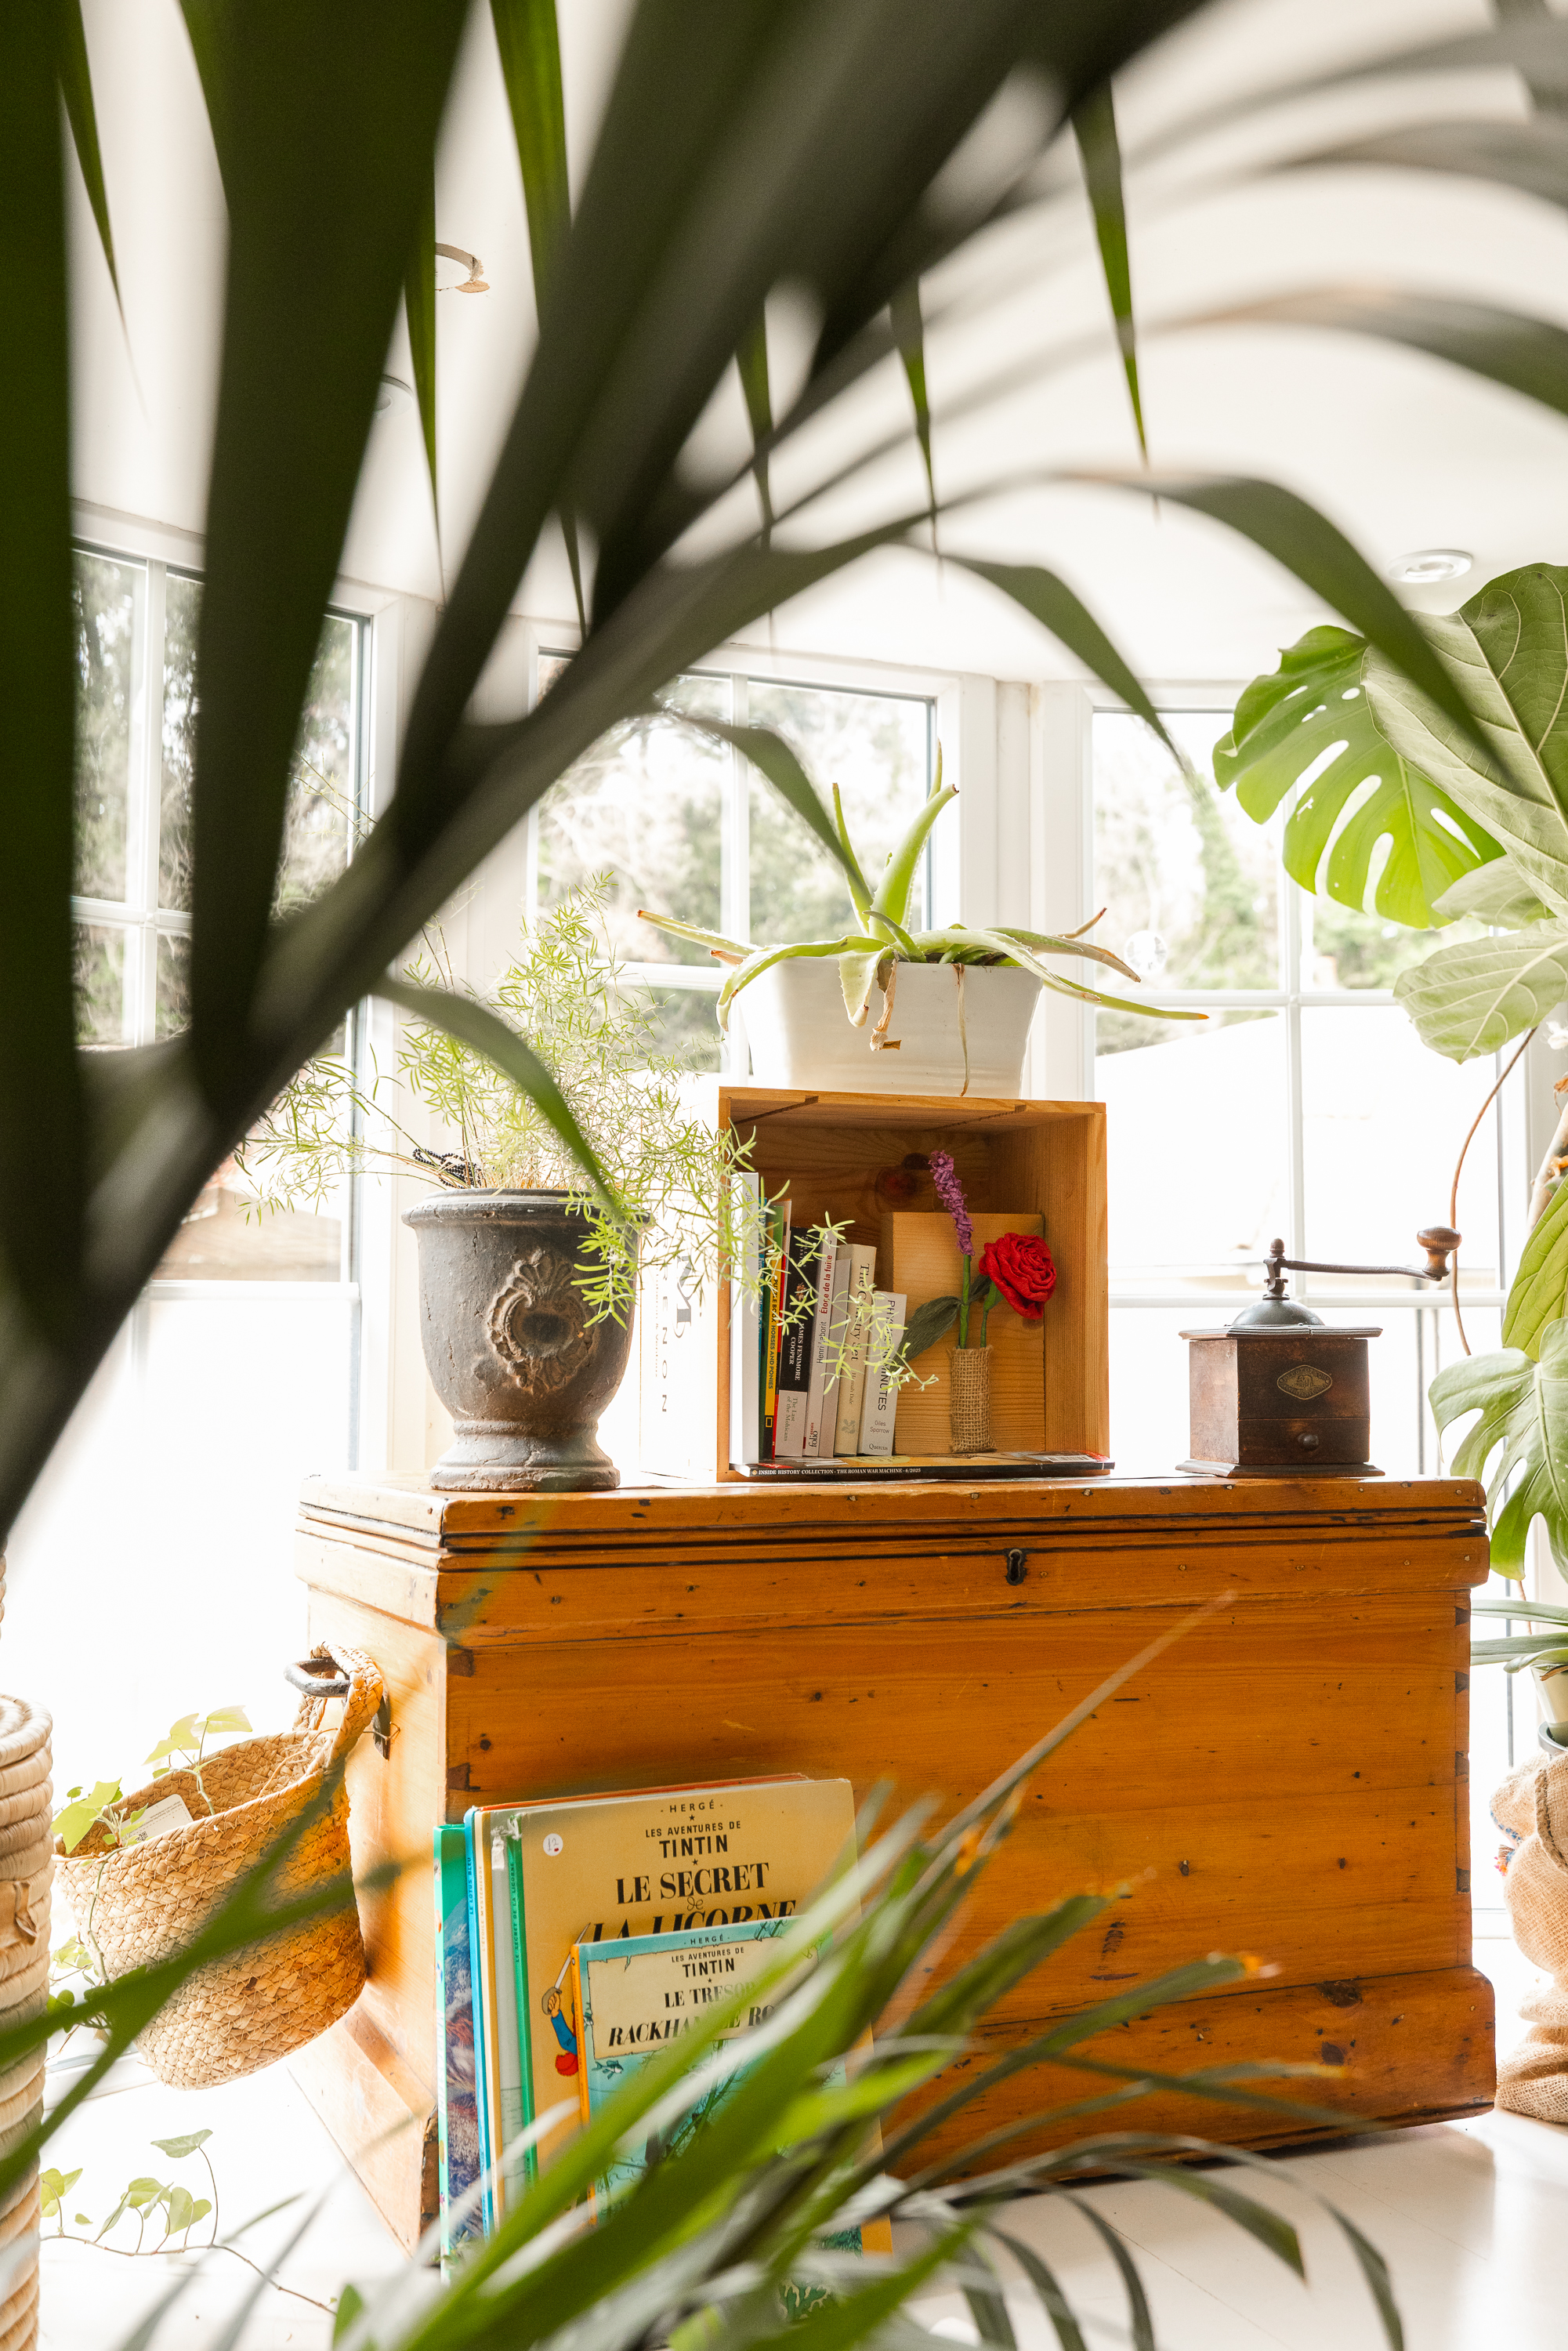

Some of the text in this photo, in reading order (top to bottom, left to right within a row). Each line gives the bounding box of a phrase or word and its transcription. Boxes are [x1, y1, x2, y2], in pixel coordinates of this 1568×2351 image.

[859, 1263, 870, 1287] The
[823, 1282, 830, 1292] de
[795, 1345, 803, 1381] FENIMORE
[808, 1430, 818, 1447] folio
[669, 1799, 715, 1813] HERGÉ
[646, 1820, 741, 1838] LES AVENTURES DE
[659, 1834, 728, 1859] TINTIN
[616, 1862, 770, 1905] LE SECRET
[469, 1907, 473, 1915] LE
[512, 1898, 516, 1907] LA
[690, 1933, 724, 1945] HERGÉ
[672, 1954, 684, 1963] LES
[688, 1948, 731, 1961] AVENTURES
[683, 1958, 734, 1978] TINTIN
[664, 1991, 685, 2009] LE
[609, 2015, 704, 2047] RACKHA
